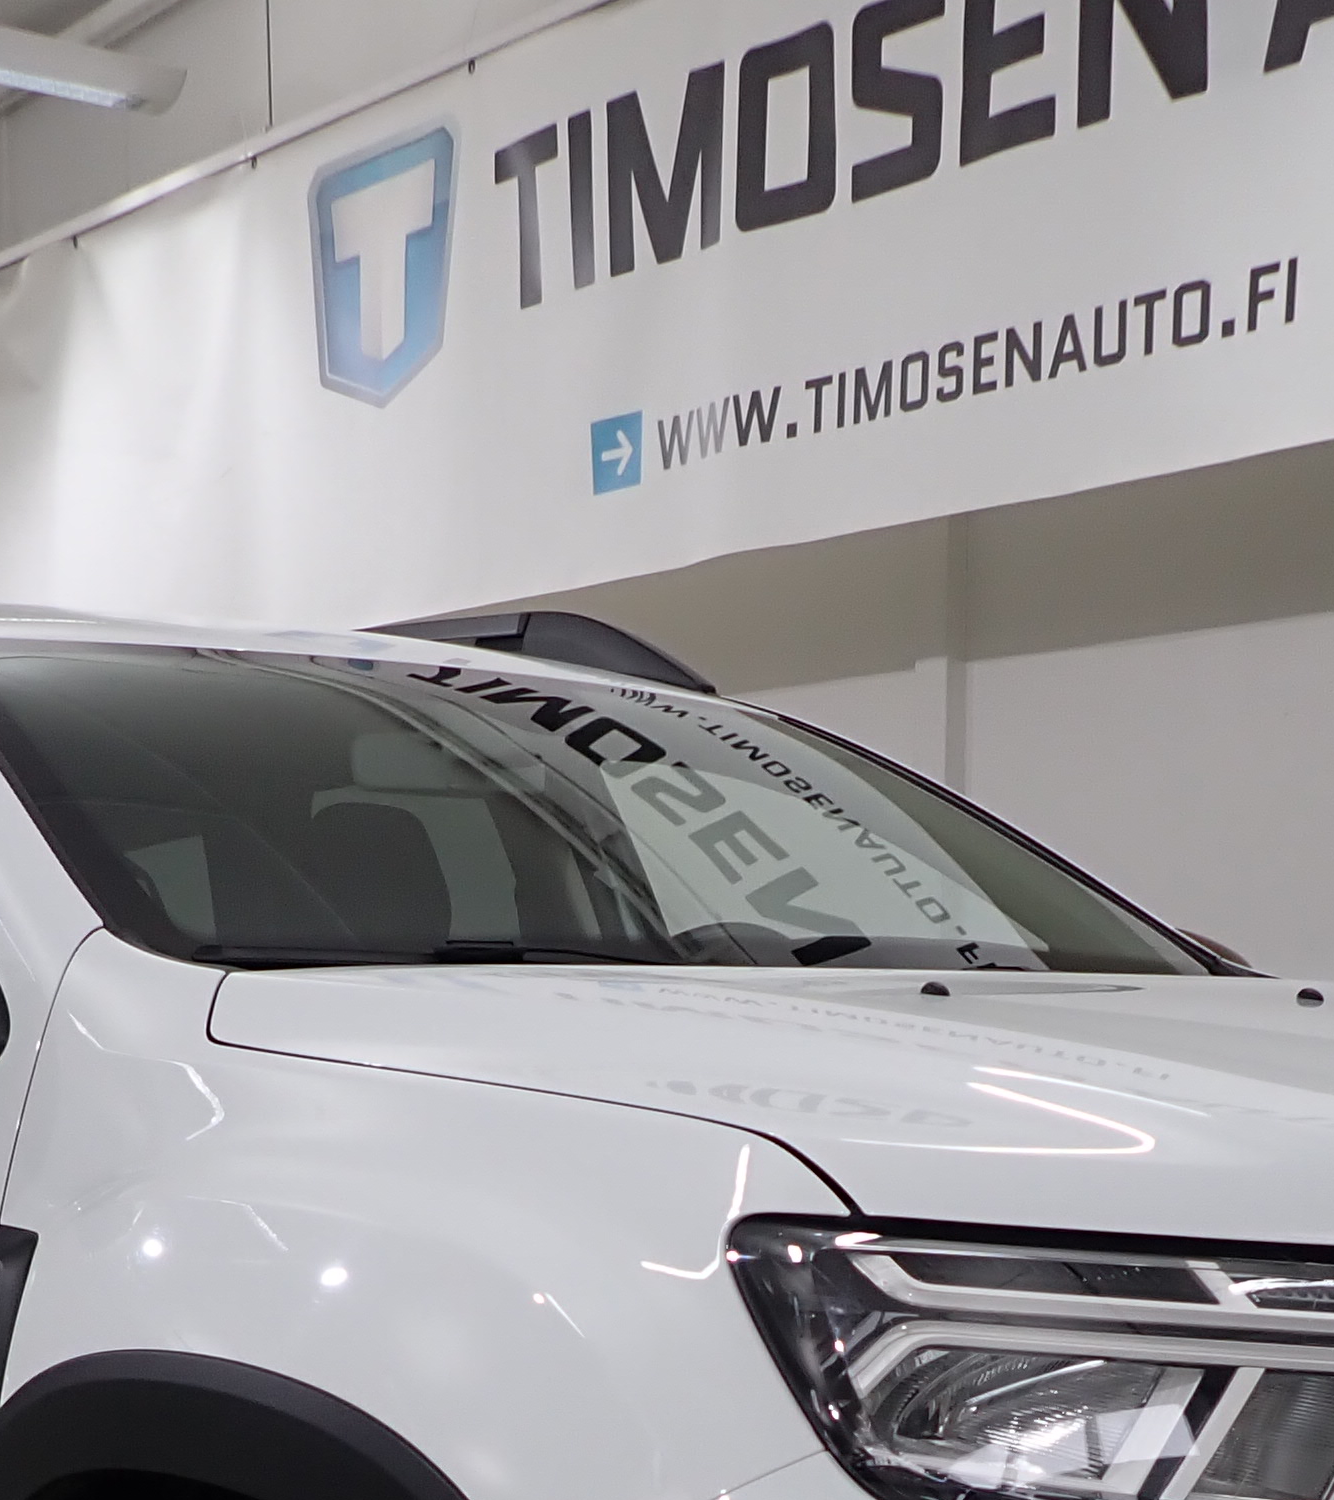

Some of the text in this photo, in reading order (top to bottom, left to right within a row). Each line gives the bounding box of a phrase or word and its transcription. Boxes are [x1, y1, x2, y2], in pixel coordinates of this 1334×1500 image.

[331, 158, 435, 361] T
[494, 0, 1209, 310] TIMOSEN
[657, 256, 1299, 470] WWW.TIMOSENAUTO.FI
